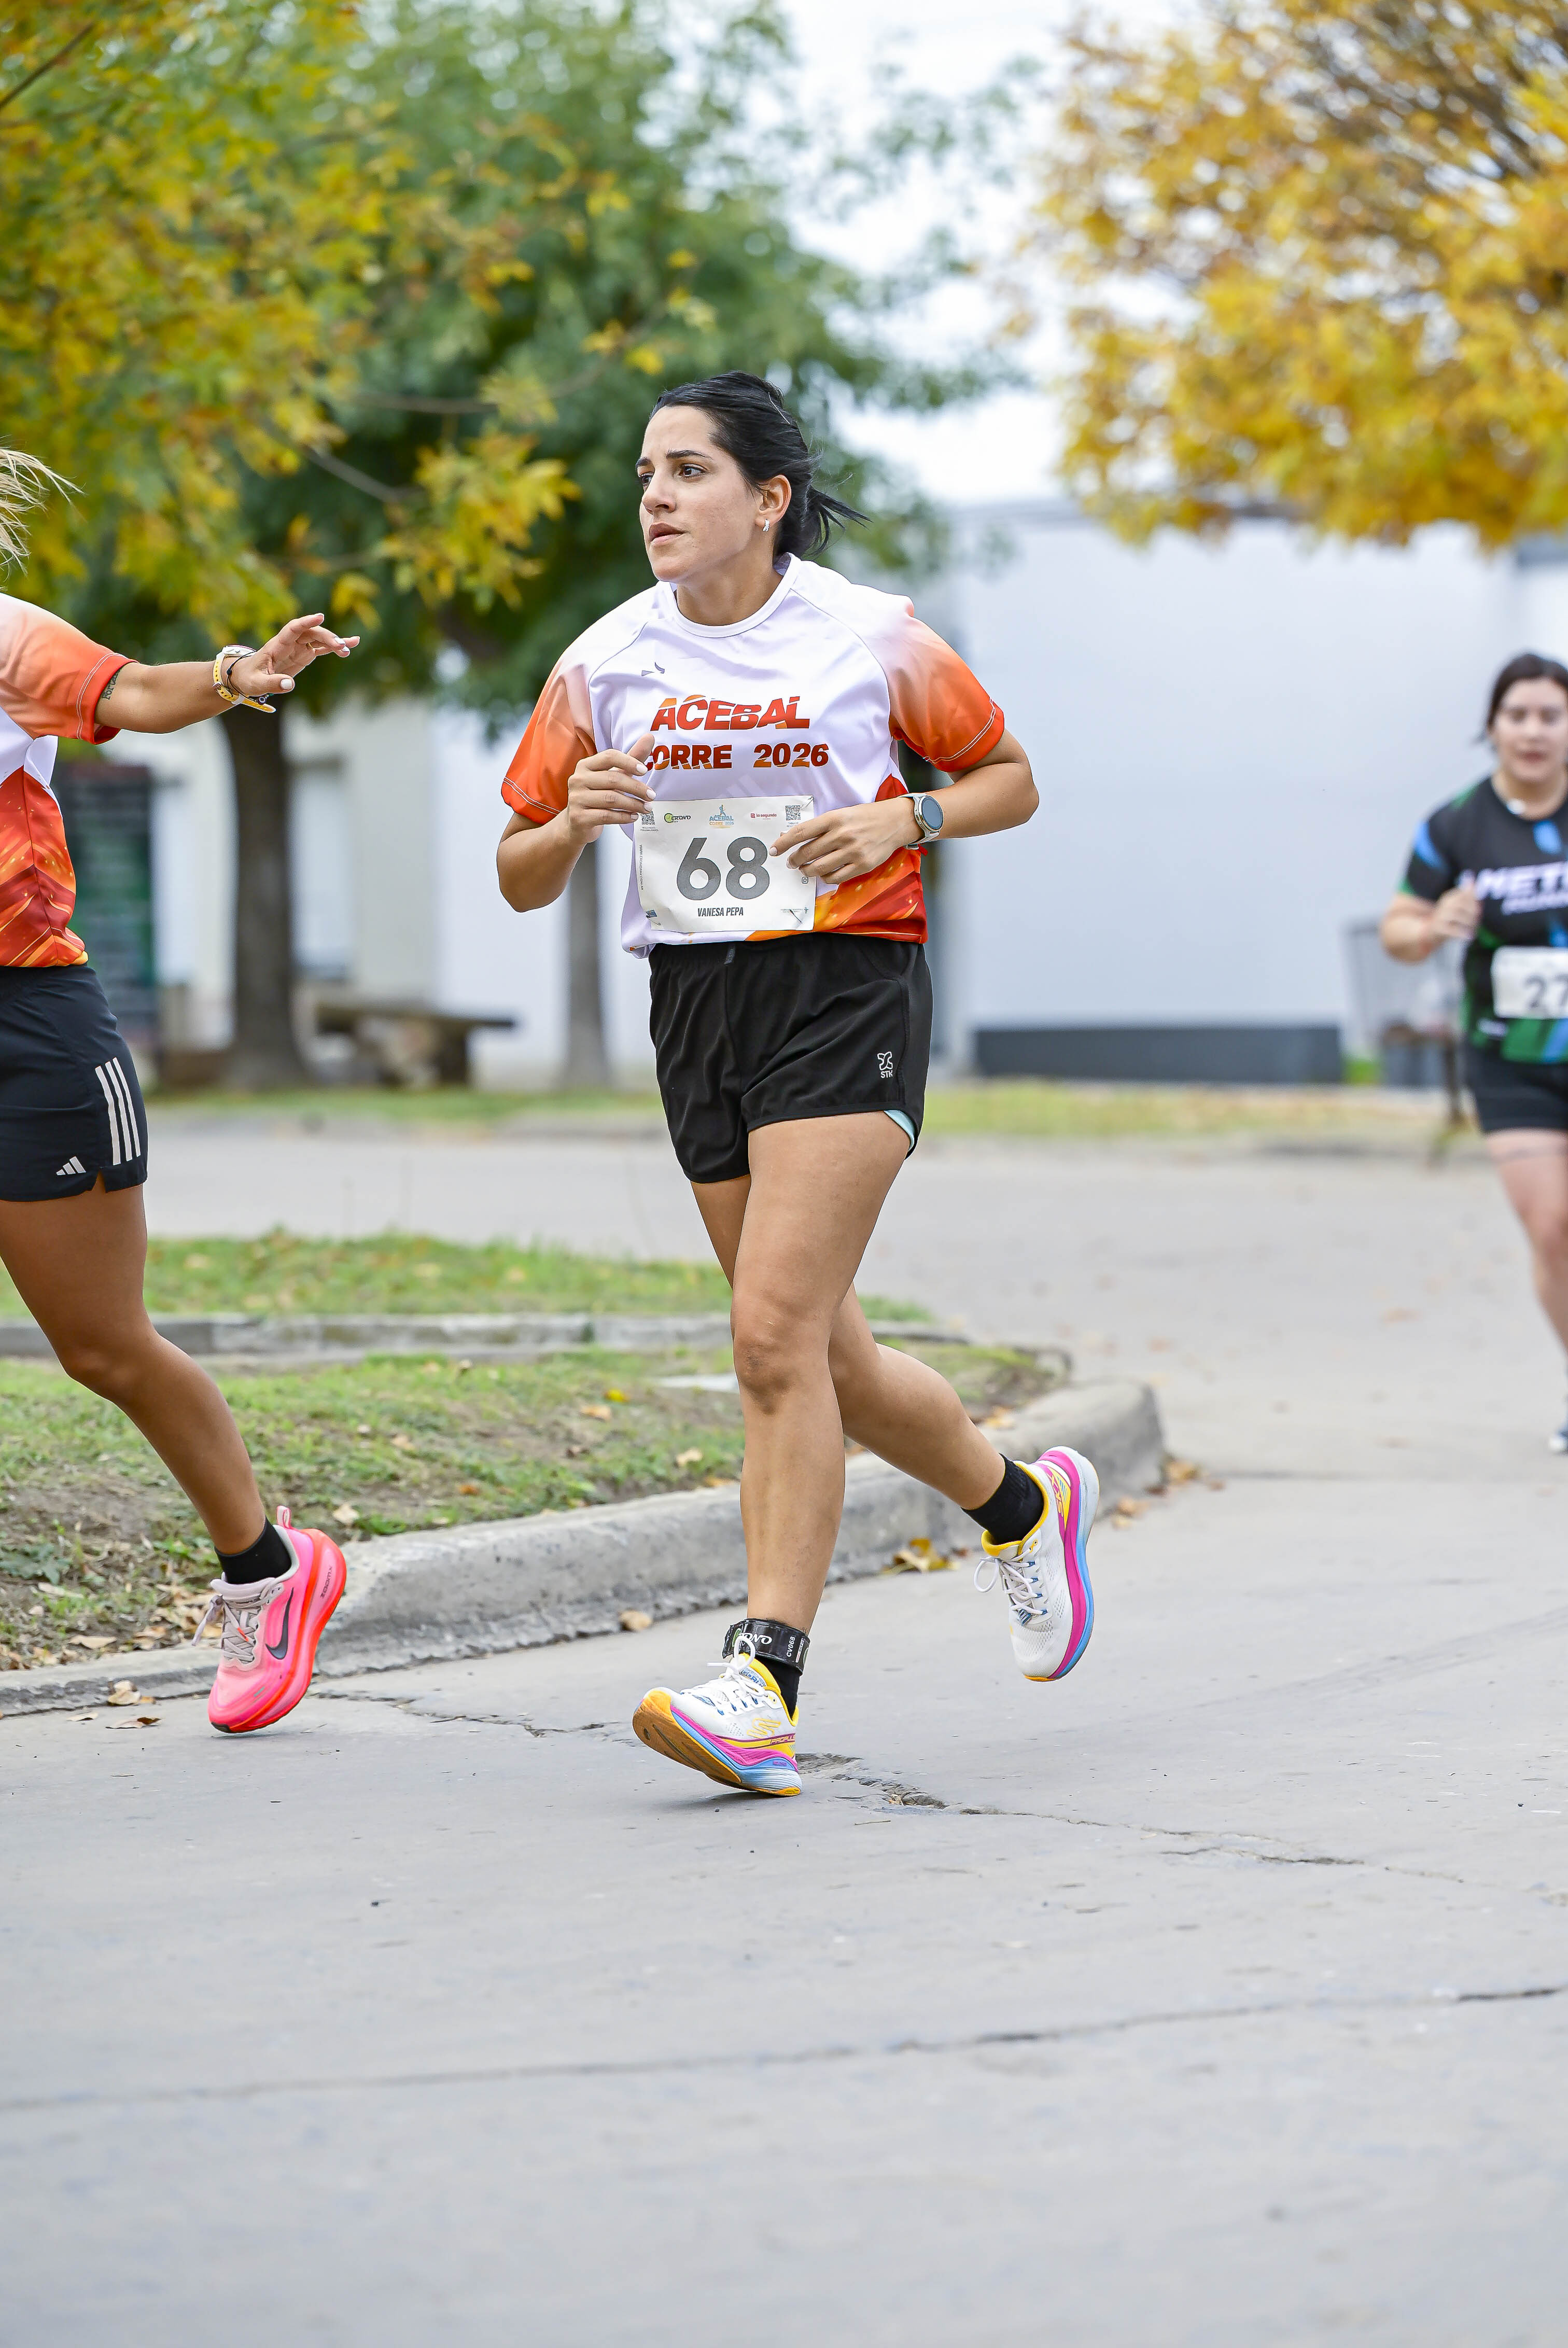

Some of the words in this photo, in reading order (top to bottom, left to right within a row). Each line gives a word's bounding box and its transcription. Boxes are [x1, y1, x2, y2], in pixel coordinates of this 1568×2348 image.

[650, 694, 810, 731] ACEBAL
[753, 743, 829, 768] 2026
[677, 836, 770, 900] 68
[697, 907, 724, 917] VANESA
[726, 907, 744, 916] PEPA
[880, 1070, 893, 1078] STK
